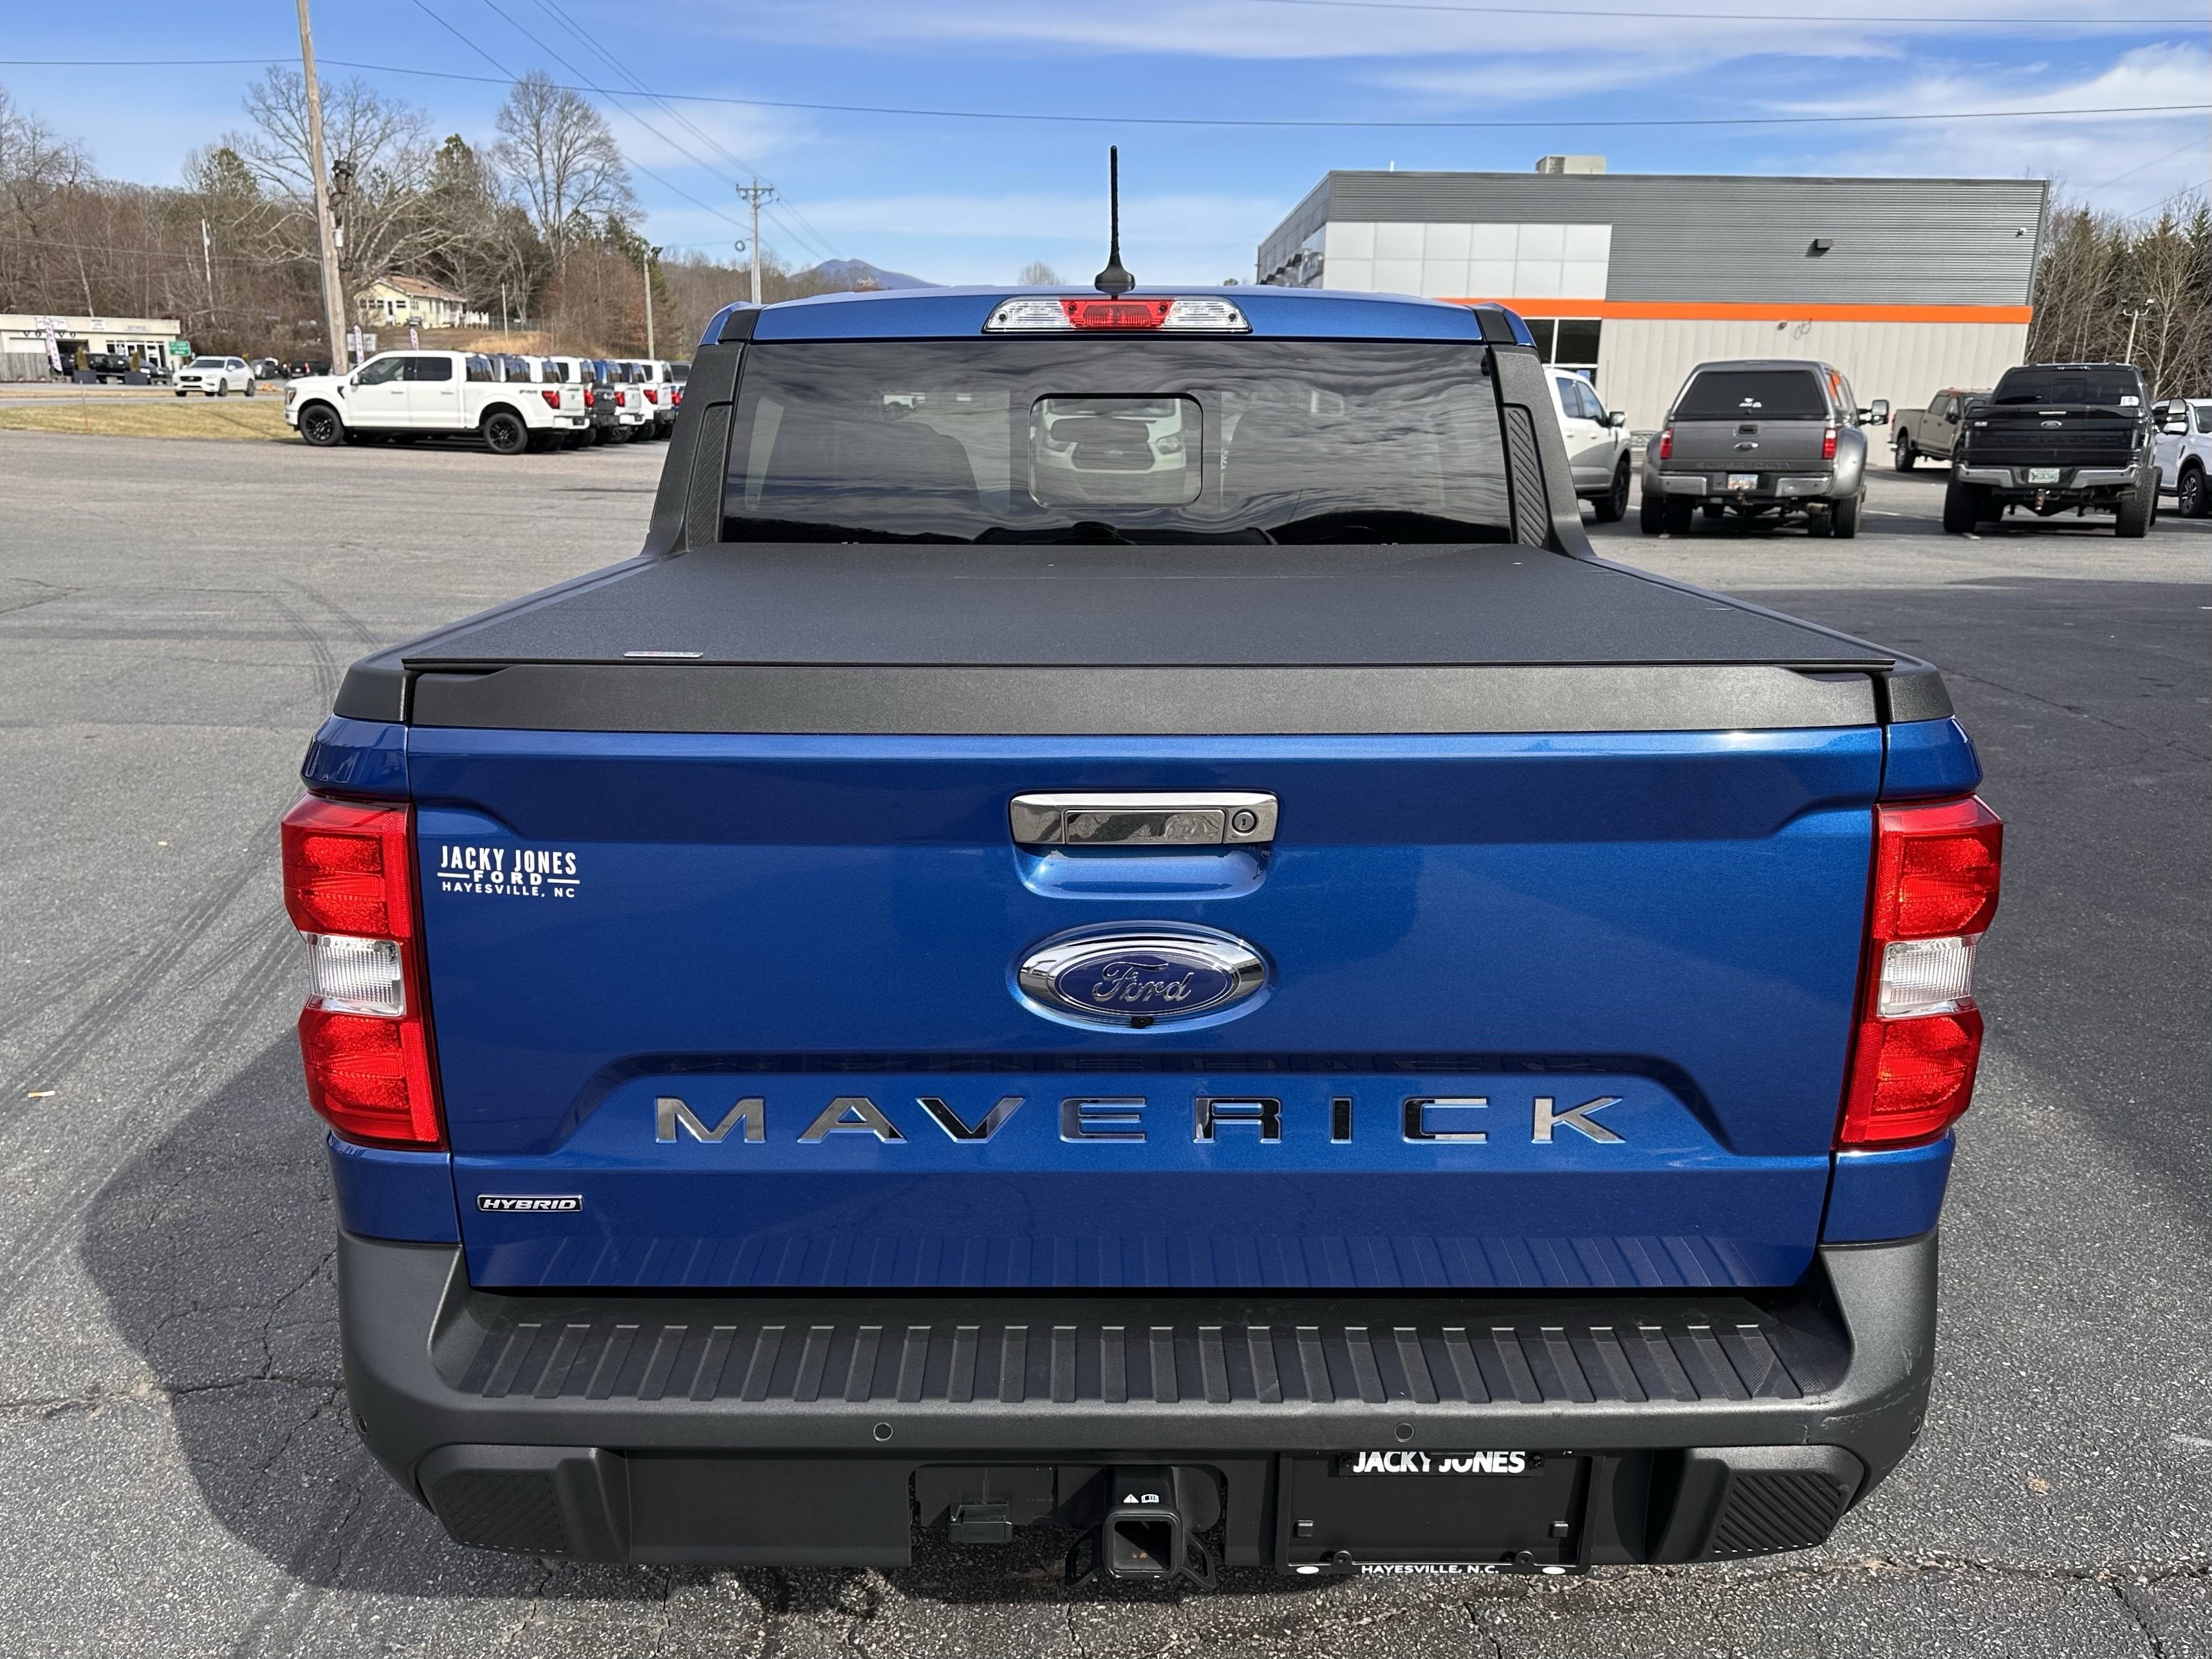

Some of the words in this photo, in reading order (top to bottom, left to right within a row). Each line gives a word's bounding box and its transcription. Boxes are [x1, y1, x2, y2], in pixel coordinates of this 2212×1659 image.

[441, 845, 505, 871] JACKY
[514, 849, 577, 875] JONES
[474, 869, 543, 885] FORD
[442, 881, 546, 898] HAYESVILLE,
[554, 887, 575, 898] NC
[1092, 961, 1194, 1003] Ford
[655, 1096, 1627, 1144] MAVERICK
[483, 1199, 577, 1210] HYBRID
[1353, 1451, 1431, 1473] JACKY
[1361, 1565, 1463, 1575] HAYESVILLE,
[1467, 1565, 1500, 1575] N.C.
